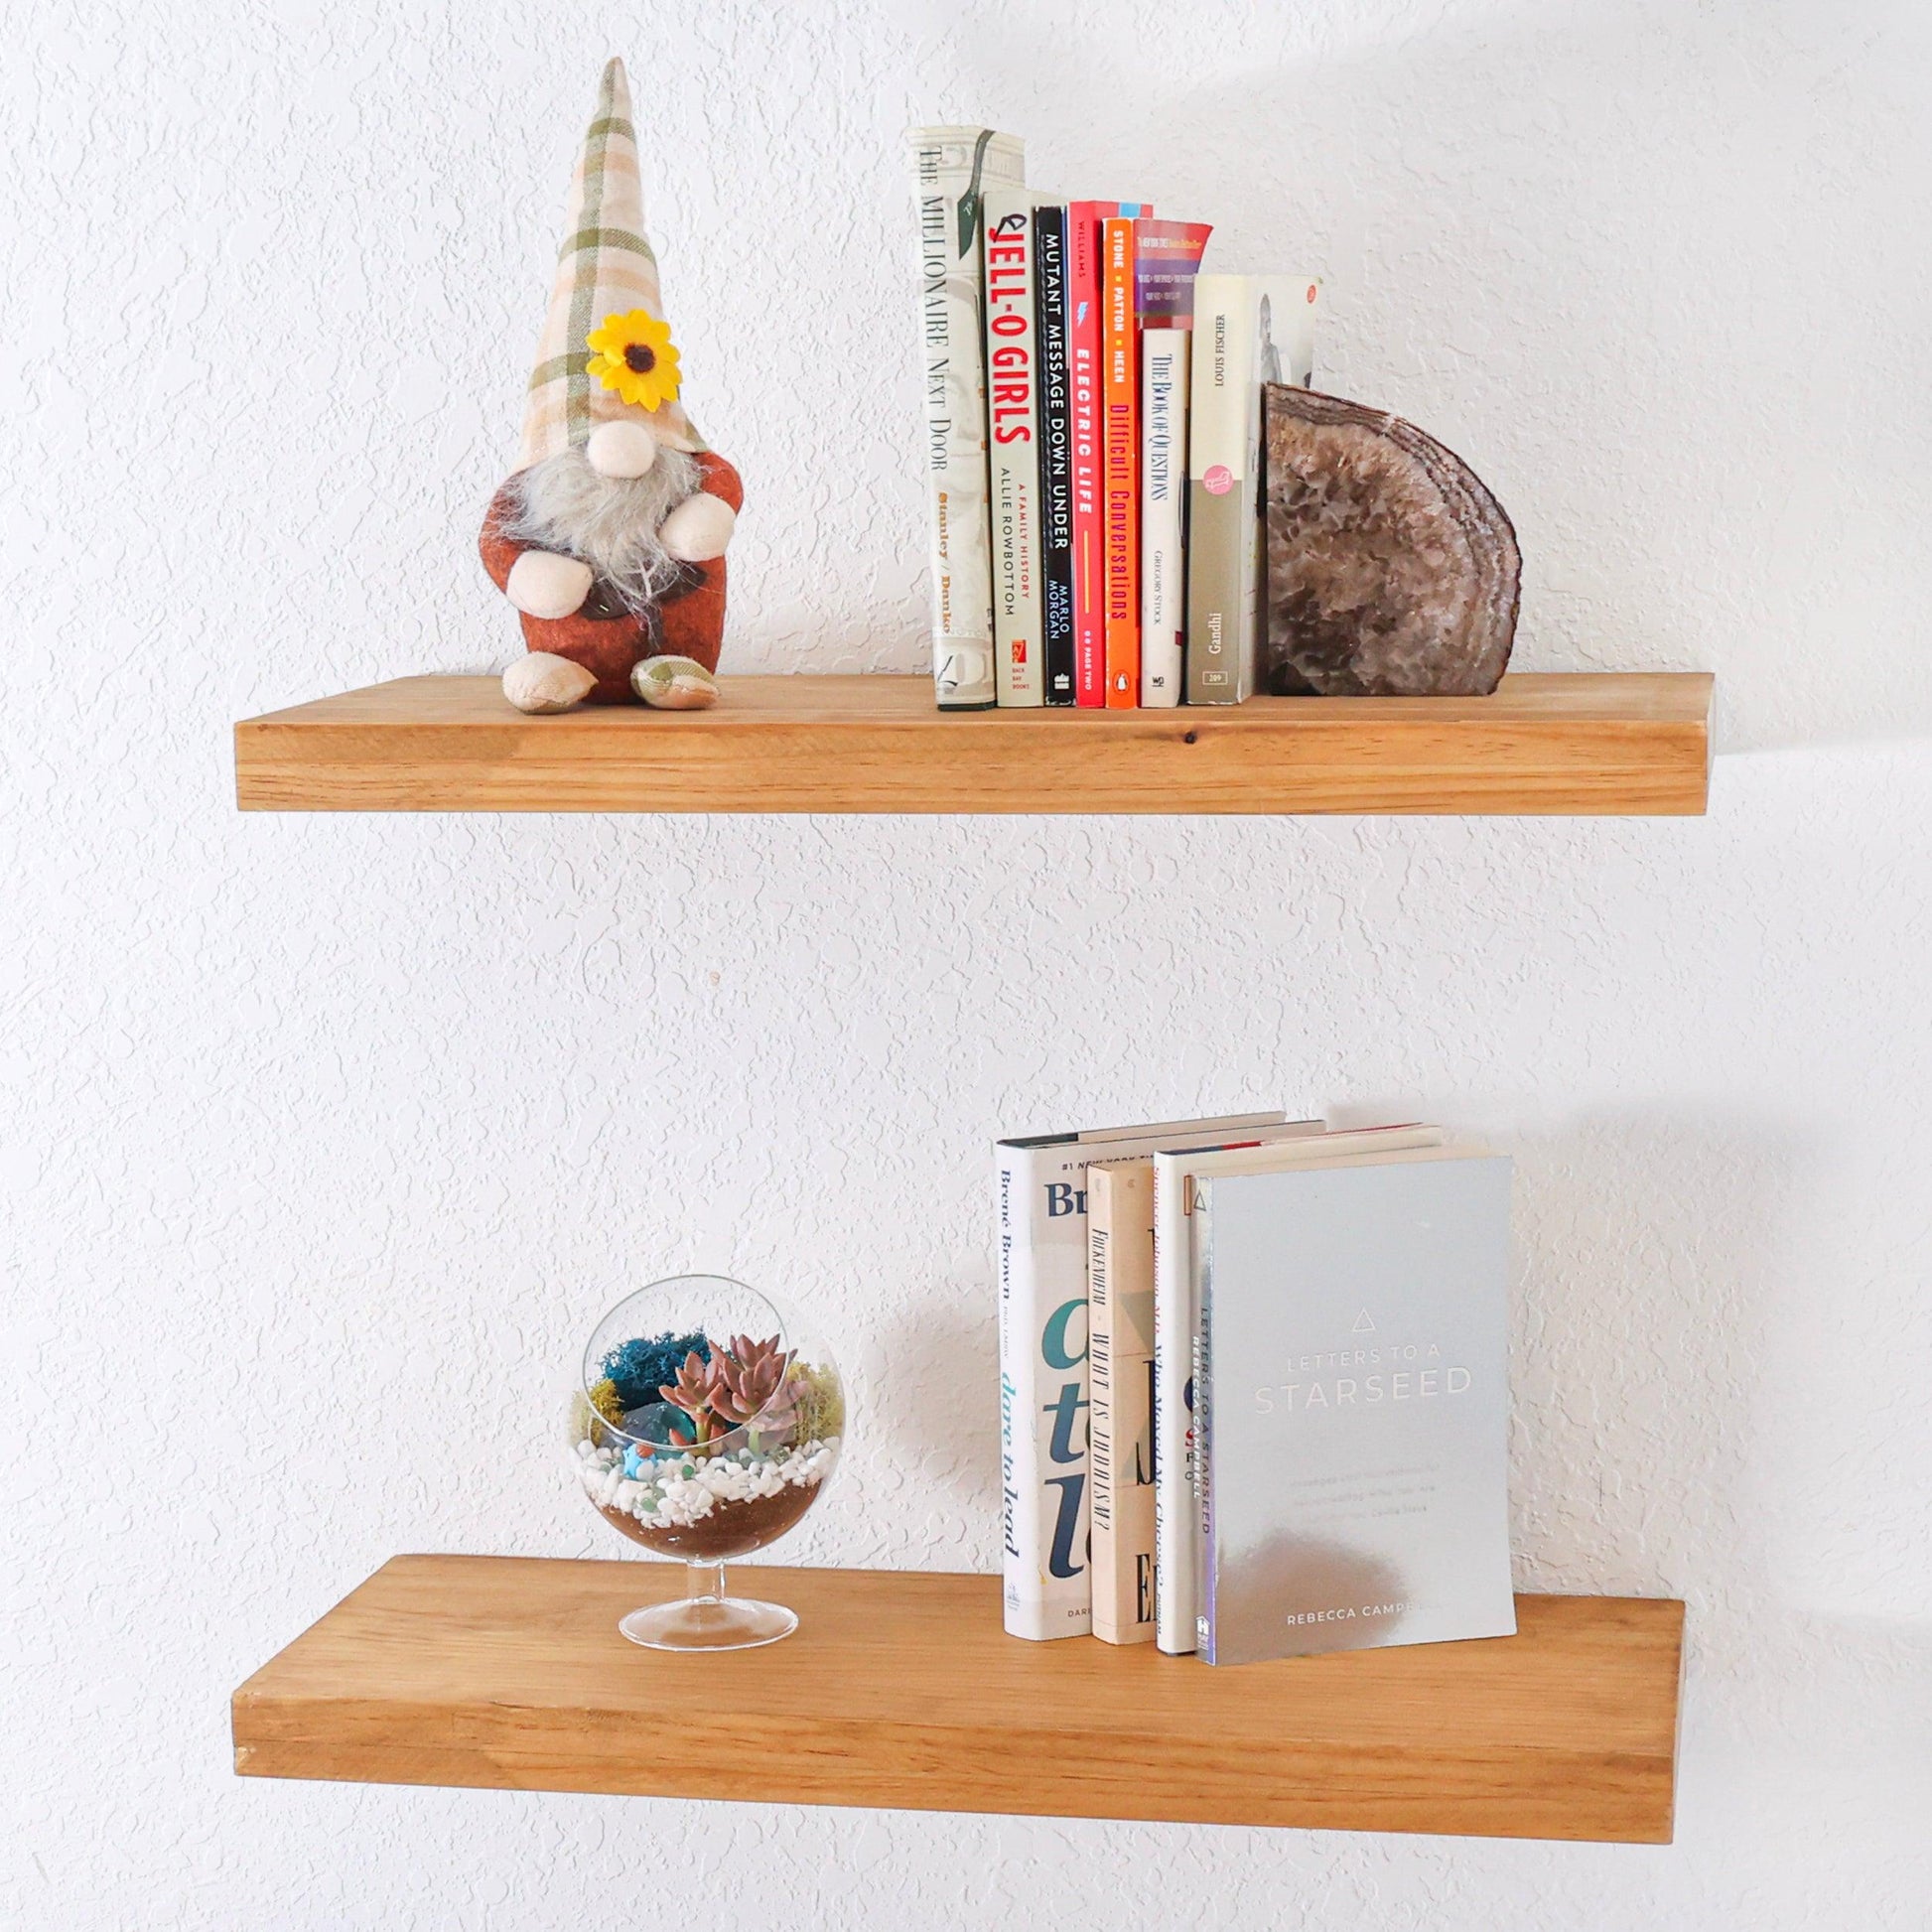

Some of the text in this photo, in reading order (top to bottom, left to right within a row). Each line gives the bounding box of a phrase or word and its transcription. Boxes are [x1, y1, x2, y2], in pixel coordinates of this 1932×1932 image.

[1077, 221, 1086, 278] WILLIAMS
[920, 146, 951, 471] THE MILLIONAIRE NEXT DOOR
[988, 227, 1032, 444] JELL-O GIRLS
[1113, 230, 1125, 383] STONE PATTON HEEN
[1215, 315, 1225, 387] LOUIS FISCHER
[1045, 233, 1068, 549] MUTANT MESSAGE DOWN UNDER
[1077, 348, 1092, 513] ELECTRIC LIFE
[938, 492, 949, 560] Stanley
[1001, 467, 1015, 616] ALLIE ROWBOTTOM
[1019, 496, 1030, 540] FAMILY
[1110, 404, 1131, 620] Difficult Conversations
[941, 576, 951, 633] Danko
[1021, 547, 1030, 599] HISTORY
[1154, 550, 1163, 625] GREGORY STOCK
[1048, 580, 1059, 639] MORGAN
[1058, 585, 1070, 633] MARLO
[1207, 613, 1222, 654] Gandhi
[1002, 1234, 1012, 1300] Brown
[1092, 1333, 1110, 1389] WHAT
[1200, 1309, 1209, 1385] LETTERS
[1288, 1343, 1441, 1372] LETTERS TO A
[1093, 1399, 1109, 1420] IS
[1192, 1335, 1202, 1499] REBECCA CAMPBELL
[1201, 1395, 1209, 1416] TO
[1254, 1366, 1472, 1415] STARSEED
[1202, 1425, 1209, 1435] A
[1002, 1372, 1020, 1559] dare to lead
[1093, 1428, 1110, 1531] JUDAISM?
[1287, 1608, 1356, 1625] REBECCA
